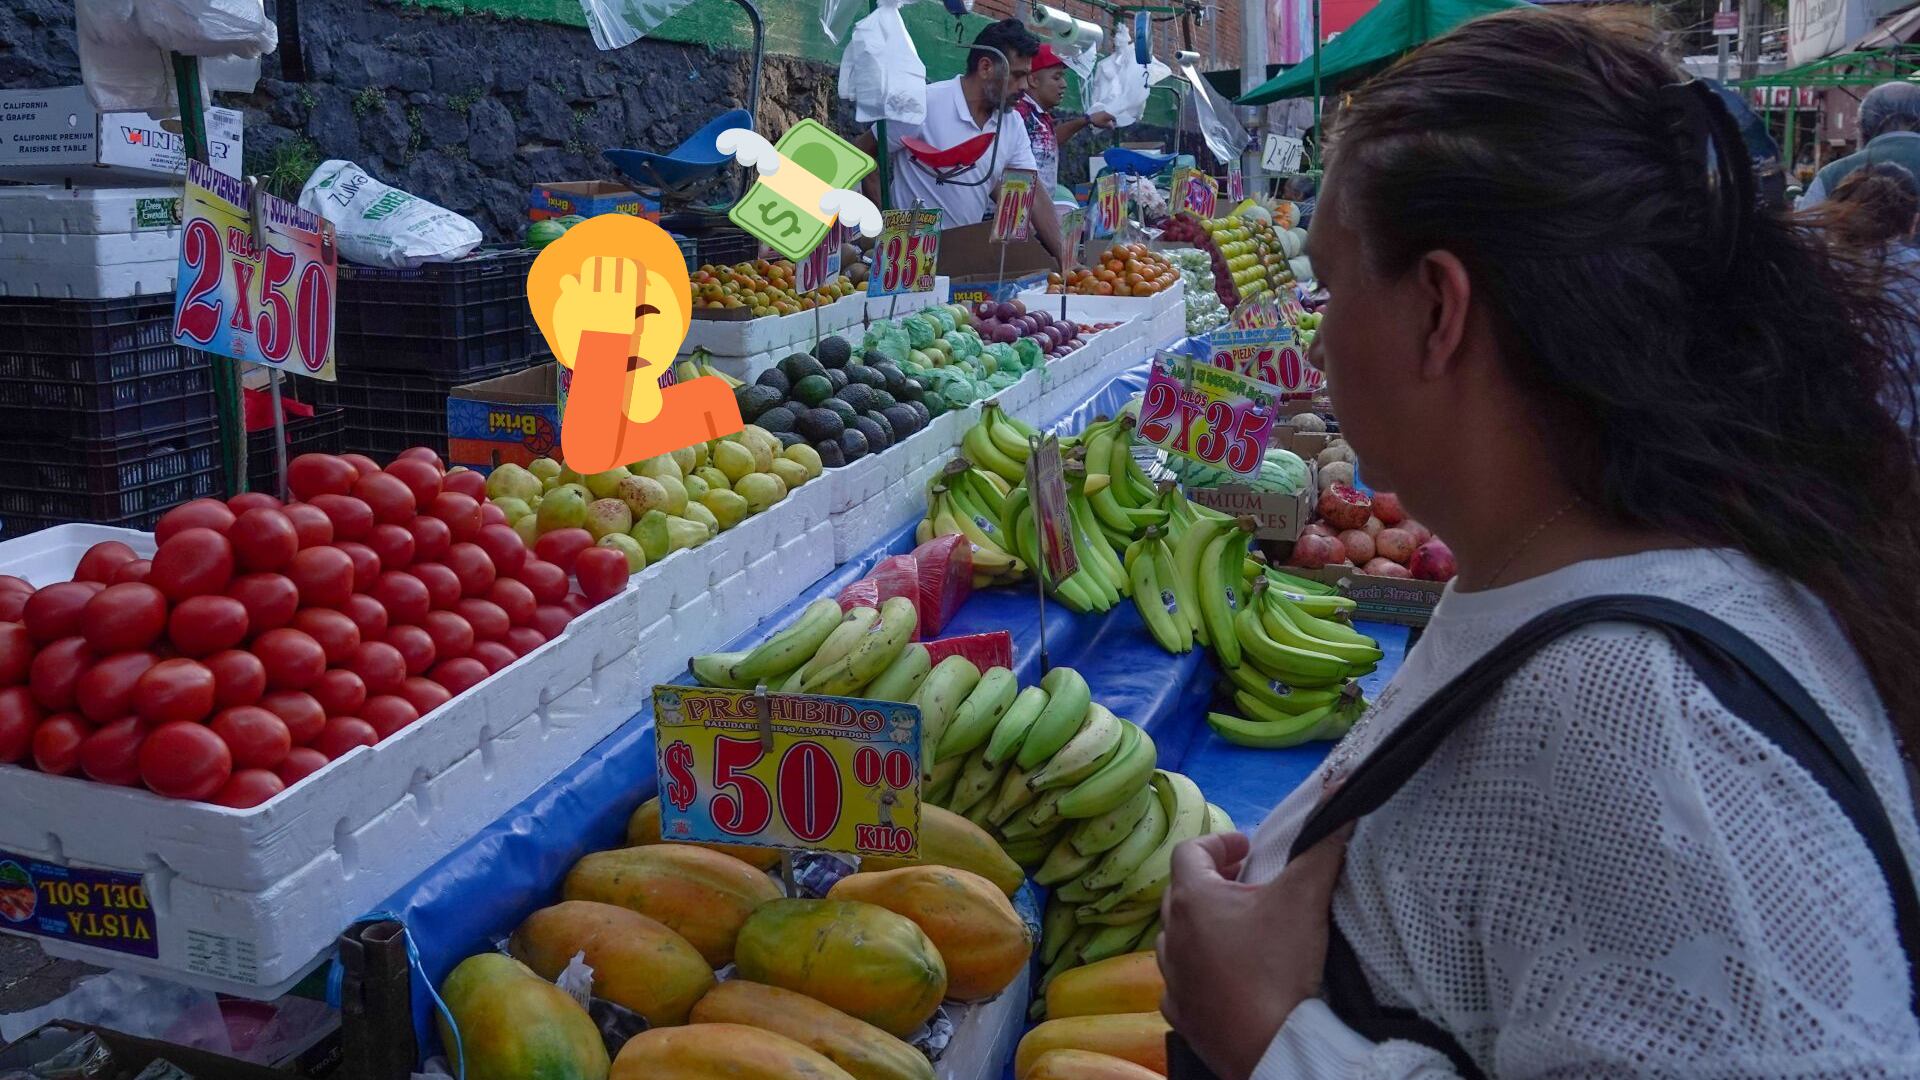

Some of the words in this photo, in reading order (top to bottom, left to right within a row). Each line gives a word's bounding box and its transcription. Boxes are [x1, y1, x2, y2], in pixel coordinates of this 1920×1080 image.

[6, 113, 36, 121] GRAPES
[13, 133, 57, 142] CALIFORNIE
[60, 132, 93, 140] PREMIUM
[19, 145, 48, 153] RAISINS
[63, 144, 87, 152] TABLE
[188, 160, 200, 185] NO
[201, 164, 212, 191] LO
[213, 169, 240, 206] PIENSE
[328, 175, 369, 208] Zulka
[270, 196, 288, 225] SOLO
[290, 202, 319, 234] CALIDAD
[884, 235, 922, 292] 35
[1232, 347, 1256, 360] PIEZAS
[1180, 388, 1209, 406] KILOS
[488, 412, 537, 436] Brixi
[1350, 585, 1382, 599] each
[704, 720, 751, 730] SALUDAR
[799, 727, 813, 735] AL
[814, 728, 870, 740] VENDEDOR
[664, 740, 698, 812] $
[709, 734, 843, 843] 50
[852, 745, 914, 790] 00
[855, 823, 914, 853] KILO
[39, 881, 90, 906] SOL
[93, 883, 149, 910] DEL
[66, 911, 151, 940] VISTA
